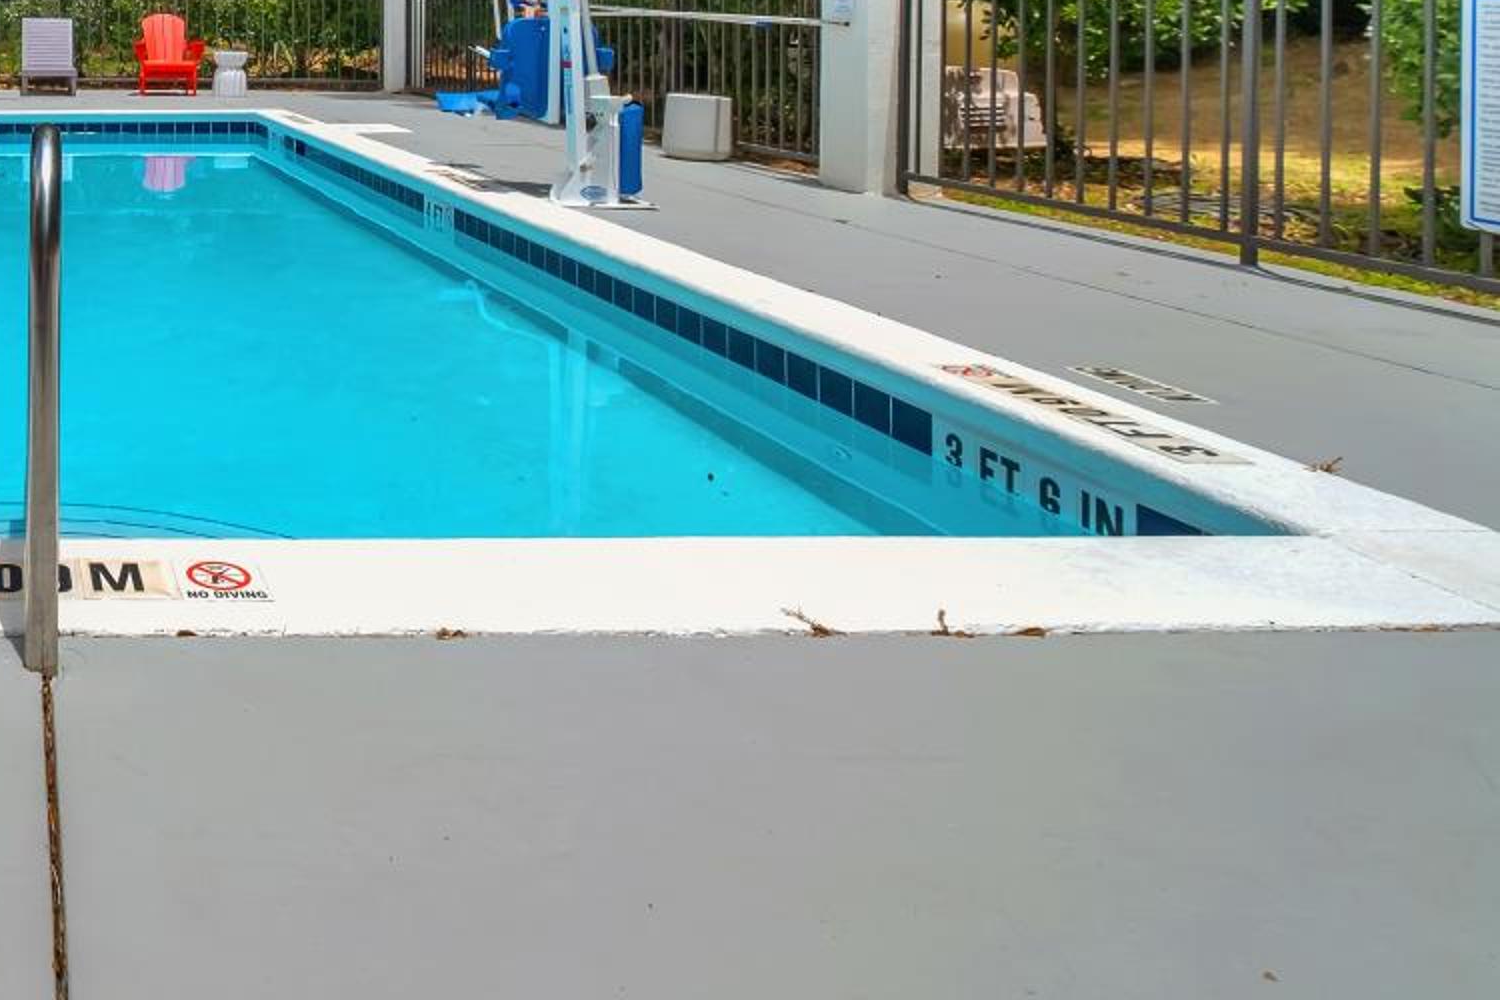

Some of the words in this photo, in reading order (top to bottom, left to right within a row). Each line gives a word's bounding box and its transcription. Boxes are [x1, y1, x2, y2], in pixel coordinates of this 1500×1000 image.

[945, 433, 963, 468] 3
[979, 446, 1021, 494] FT
[1039, 476, 1061, 515] 6
[1081, 489, 1124, 537] IN
[186, 590, 209, 599] NO
[213, 590, 268, 599] DIVING
